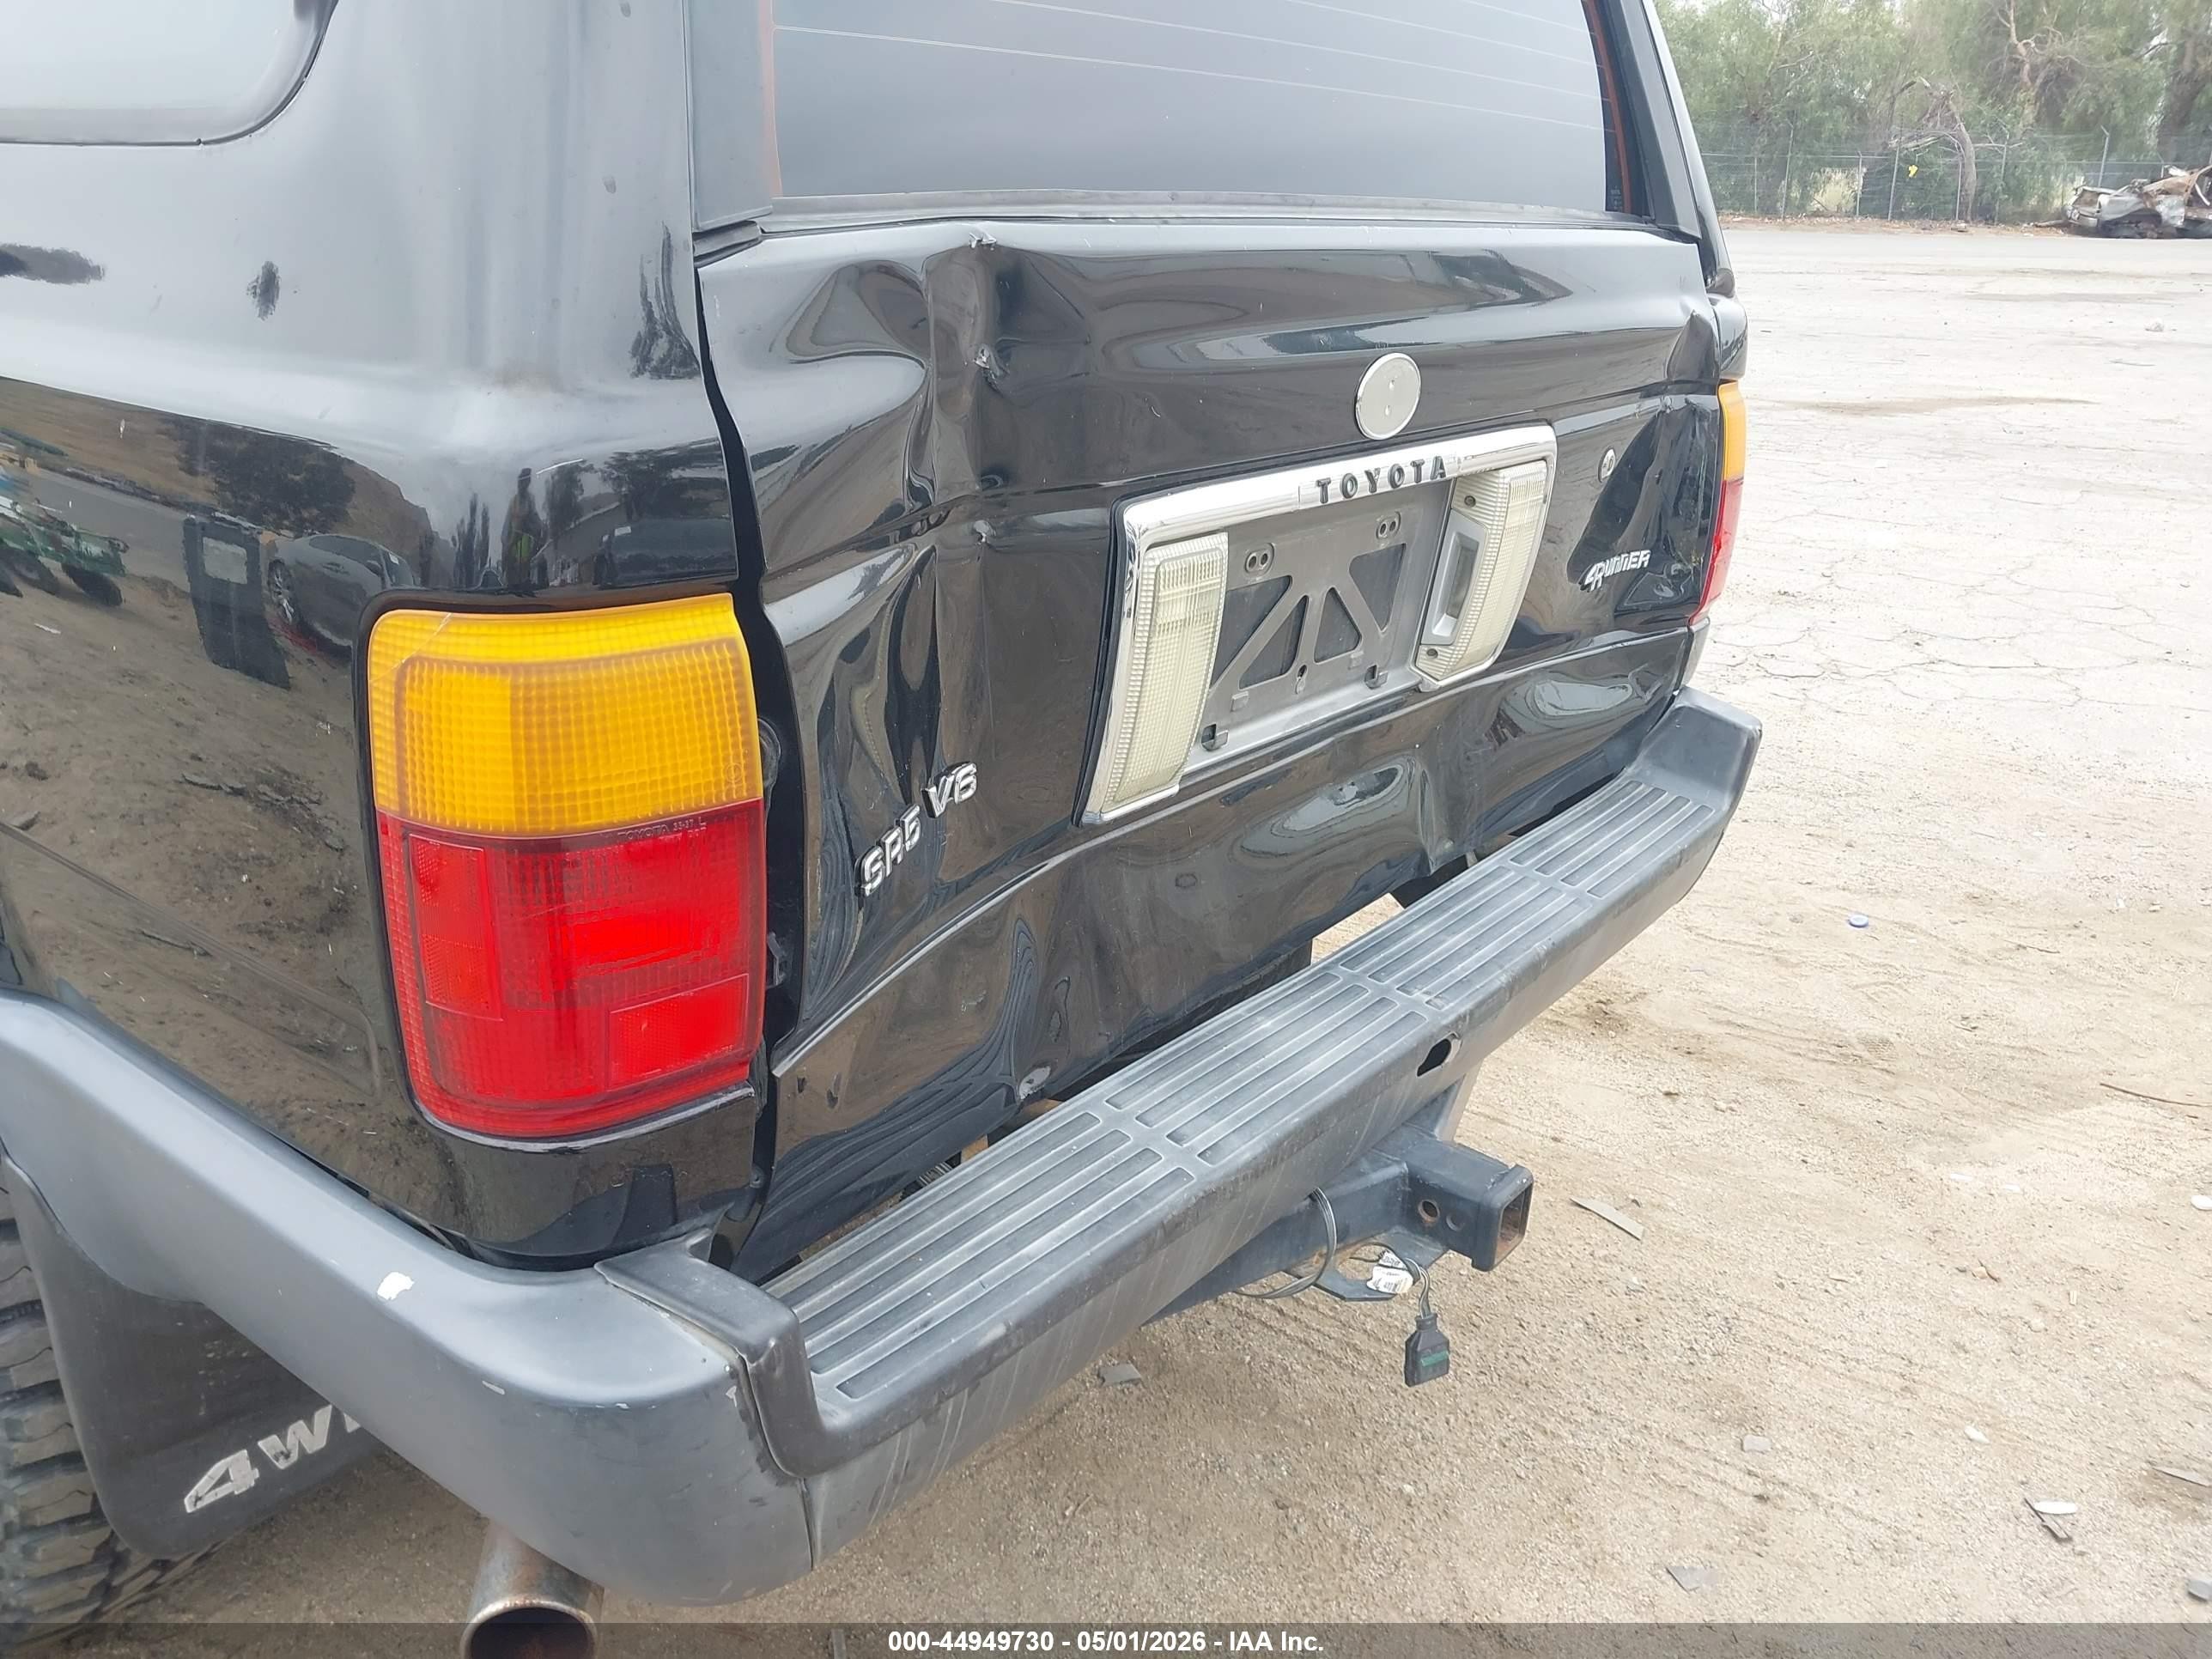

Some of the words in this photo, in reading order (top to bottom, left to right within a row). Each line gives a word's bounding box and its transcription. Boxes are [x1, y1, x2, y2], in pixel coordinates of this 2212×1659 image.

[1316, 455, 1447, 504] TOYOTA
[1583, 550, 1651, 592] 4RUNNER
[617, 824, 670, 840] TOYOTA
[859, 804, 921, 896] SR5
[921, 761, 977, 818] V6
